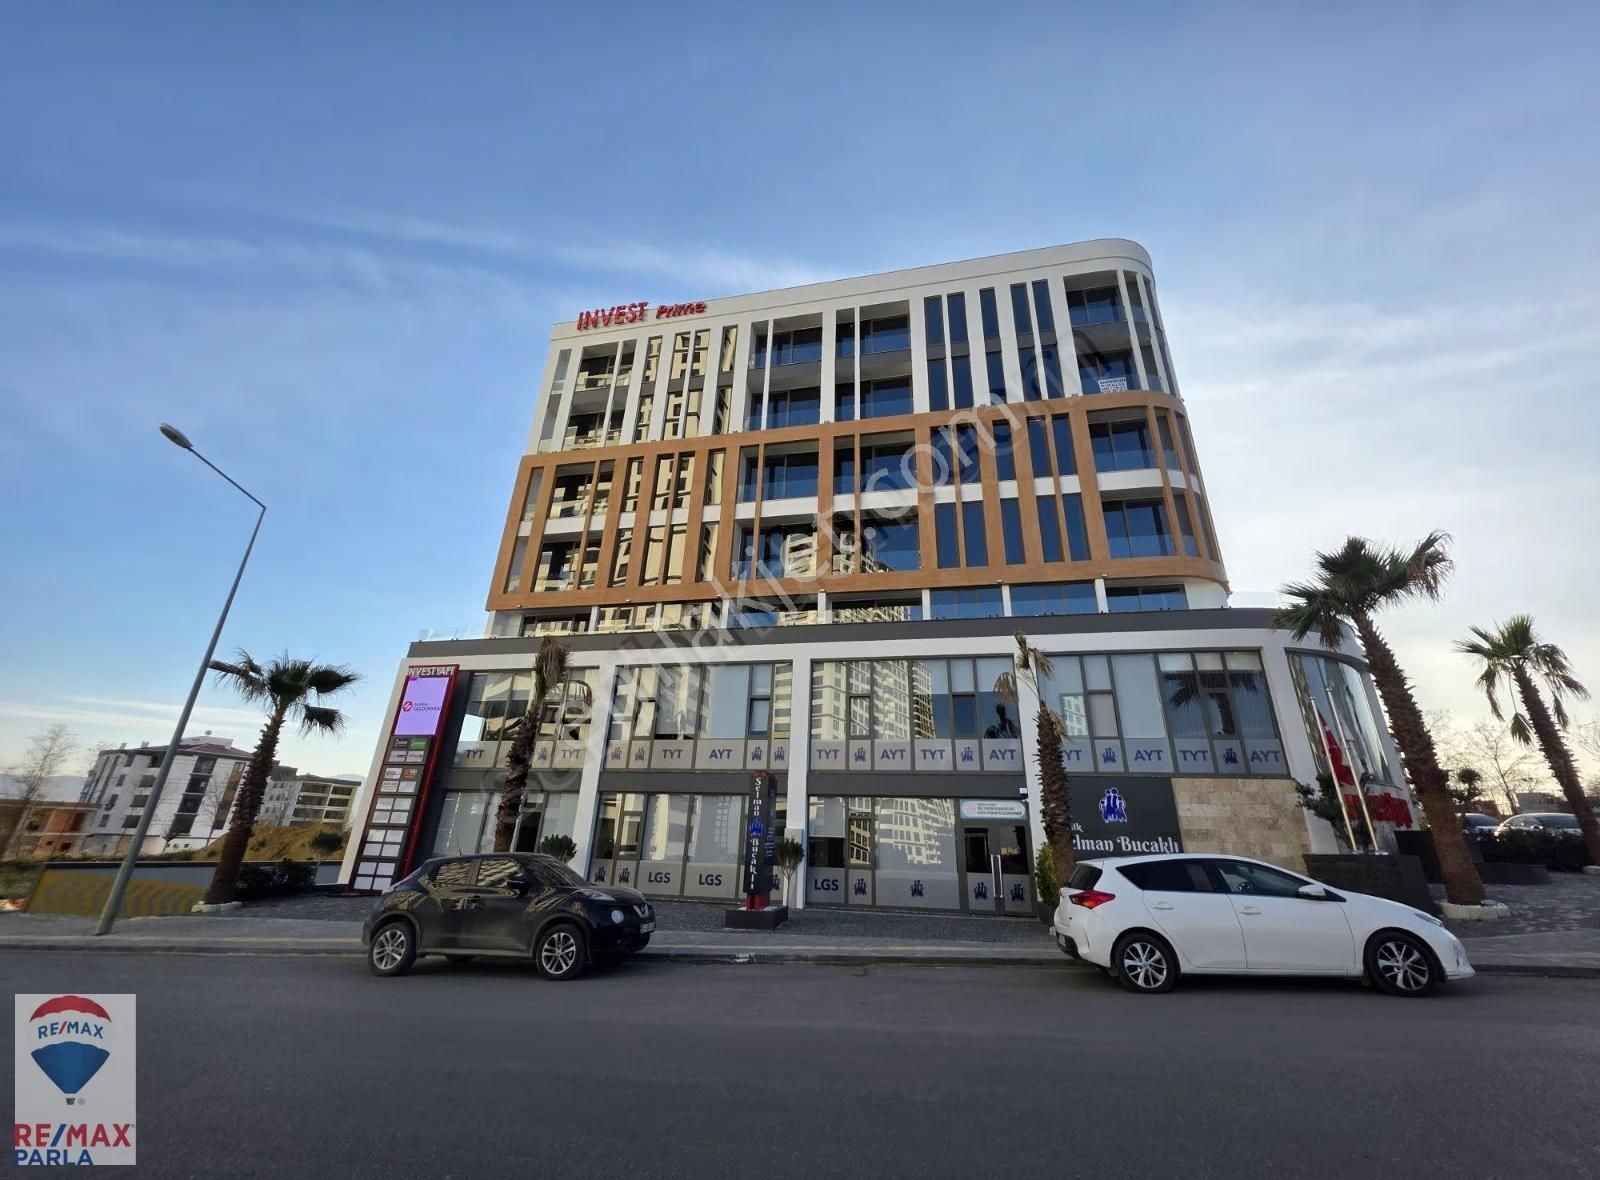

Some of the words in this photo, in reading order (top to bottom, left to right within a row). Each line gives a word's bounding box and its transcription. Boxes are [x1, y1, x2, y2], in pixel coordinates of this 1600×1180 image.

[576, 301, 649, 331] INVEST
[655, 301, 707, 319] Prime
[466, 749, 484, 759] TYT
[561, 749, 581, 759] TYT
[661, 749, 684, 760] TYT
[708, 749, 733, 760] AYT
[816, 749, 839, 760] TYT
[880, 749, 906, 760] AYT
[920, 749, 946, 760] TYT
[989, 749, 1016, 761] AYT
[1063, 750, 1083, 761] YT
[1134, 750, 1164, 762] AYT
[1179, 750, 1209, 762] TYT
[1250, 751, 1281, 763] AYT
[648, 872, 671, 884] LGS
[698, 874, 722, 887] LGS
[814, 878, 839, 891] LGS
